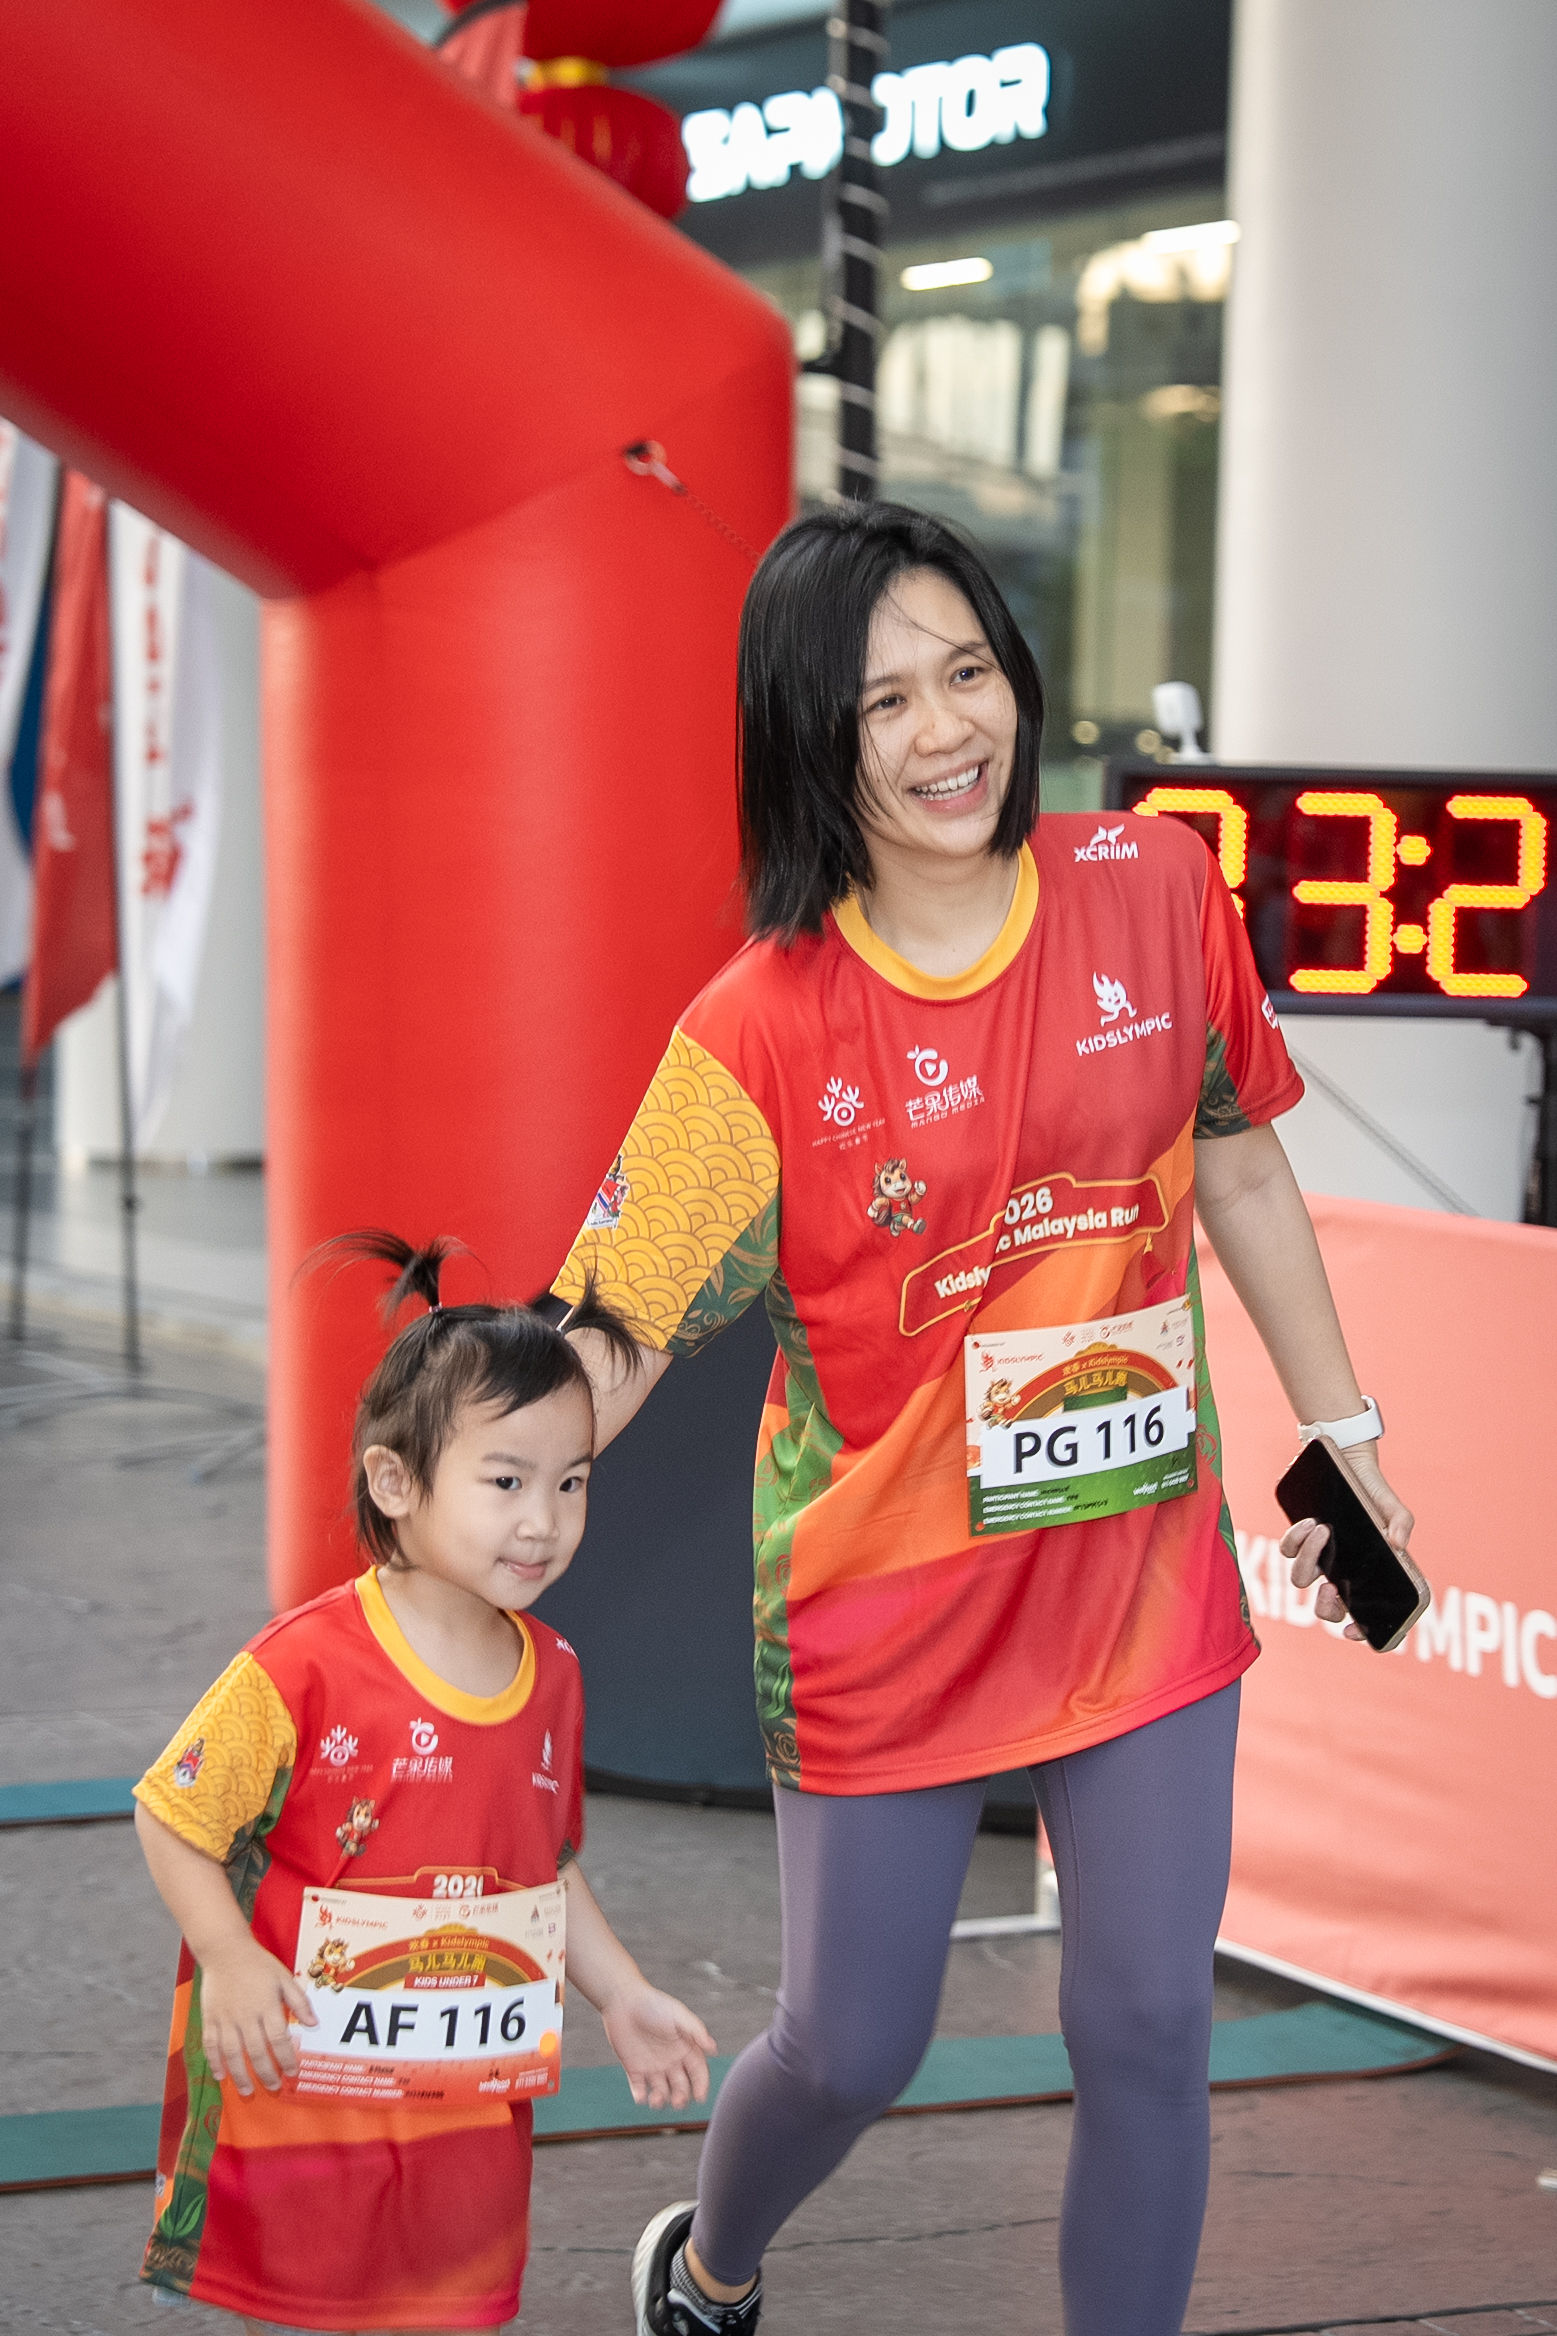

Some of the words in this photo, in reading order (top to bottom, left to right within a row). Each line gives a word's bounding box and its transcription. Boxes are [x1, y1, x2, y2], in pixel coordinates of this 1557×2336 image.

[1076, 1012, 1173, 1056] KIDSLYMPIC
[905, 1075, 983, 1121] 芒果传媒
[911, 1112, 948, 1129] MANGO
[952, 1096, 985, 1114] MEDIA
[1004, 1186, 1054, 1225] 026
[1014, 1207, 1108, 1247] Malaysia
[1111, 1203, 1140, 1228] Run
[1014, 1426, 1079, 1474] PG
[1096, 1404, 1164, 1461] 116
[1235, 1530, 1557, 1700] KIDMPIC
[413, 1976, 438, 1988] KIDS
[438, 1975, 472, 1988] UNDER
[472, 1974, 479, 1987] 7
[339, 2000, 419, 2047] AF
[440, 1996, 527, 2048] 116
